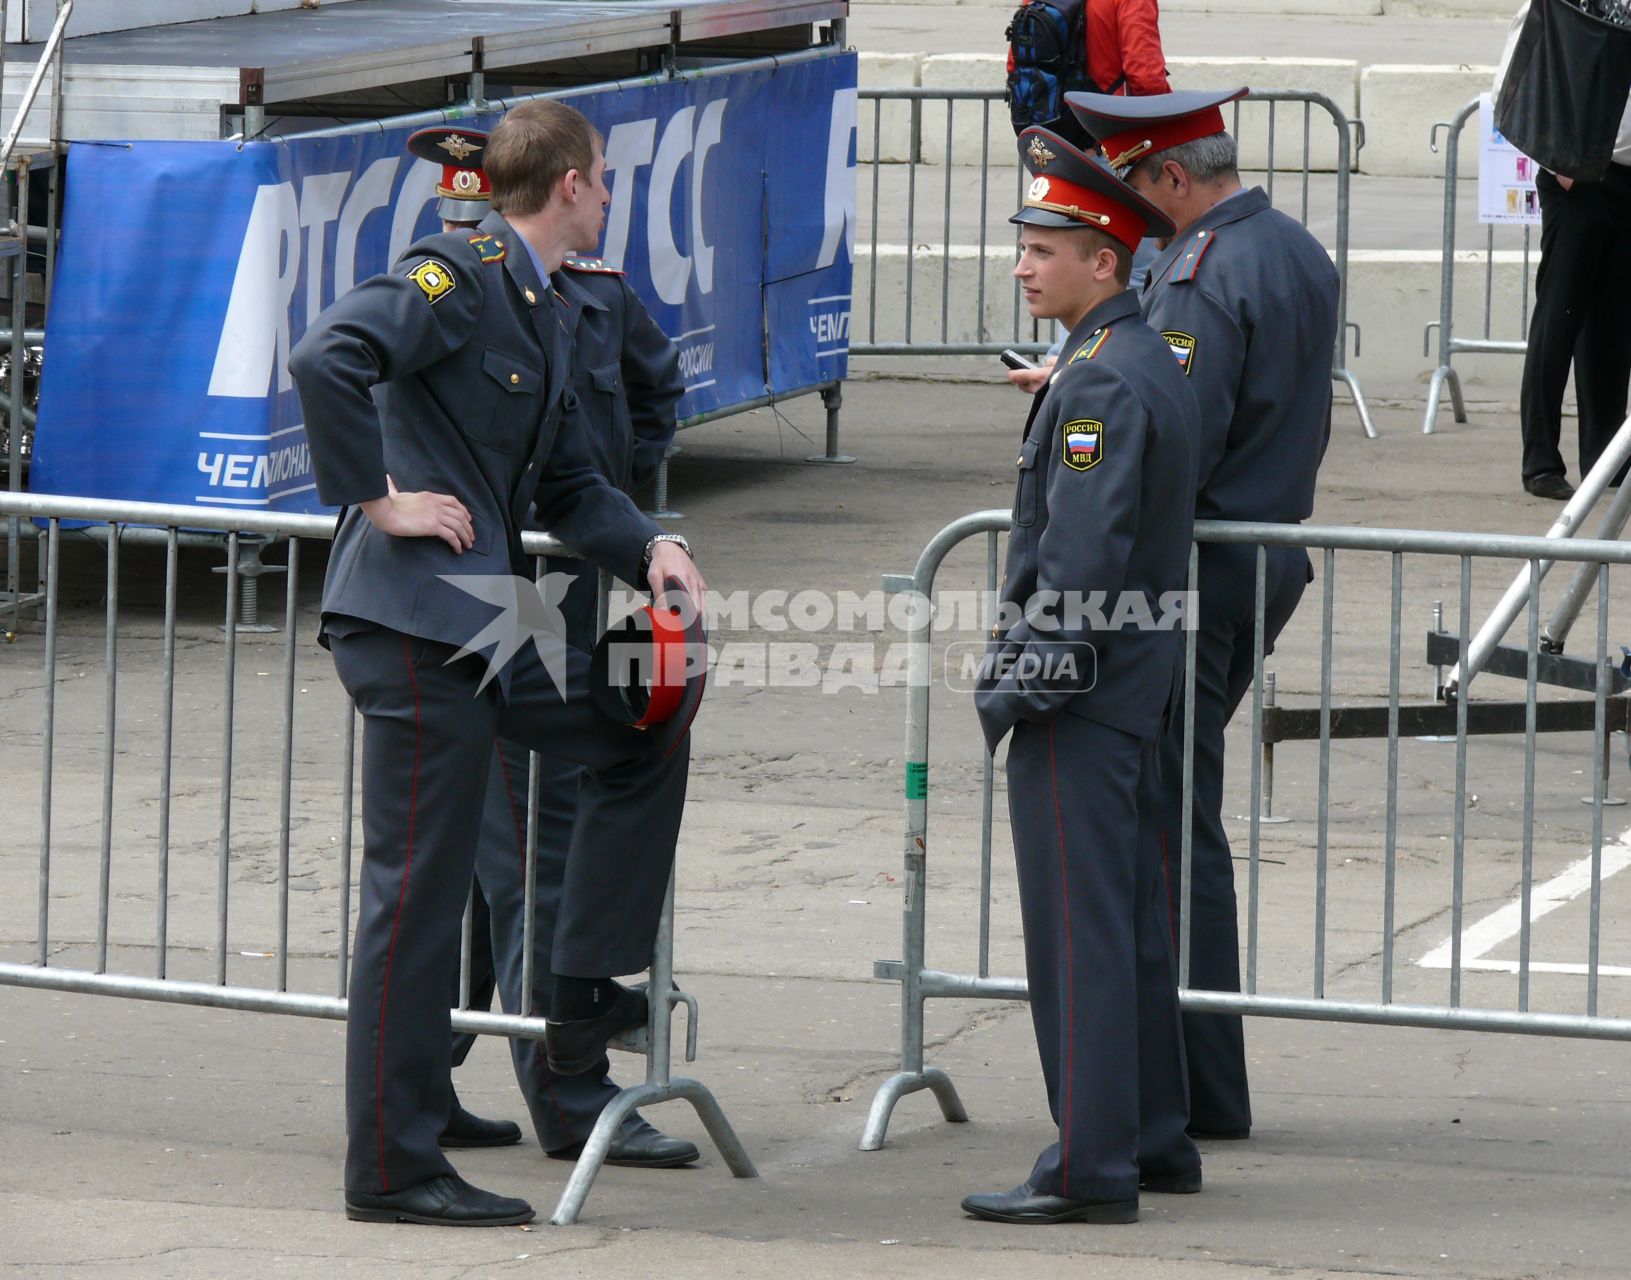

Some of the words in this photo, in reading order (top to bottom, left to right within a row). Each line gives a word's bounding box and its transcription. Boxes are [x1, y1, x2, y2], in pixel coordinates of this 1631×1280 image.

[1163, 336, 1194, 347] ОССИЯ
[1066, 424, 1099, 434] РОССИЯ
[1072, 453, 1092, 463] МВД
